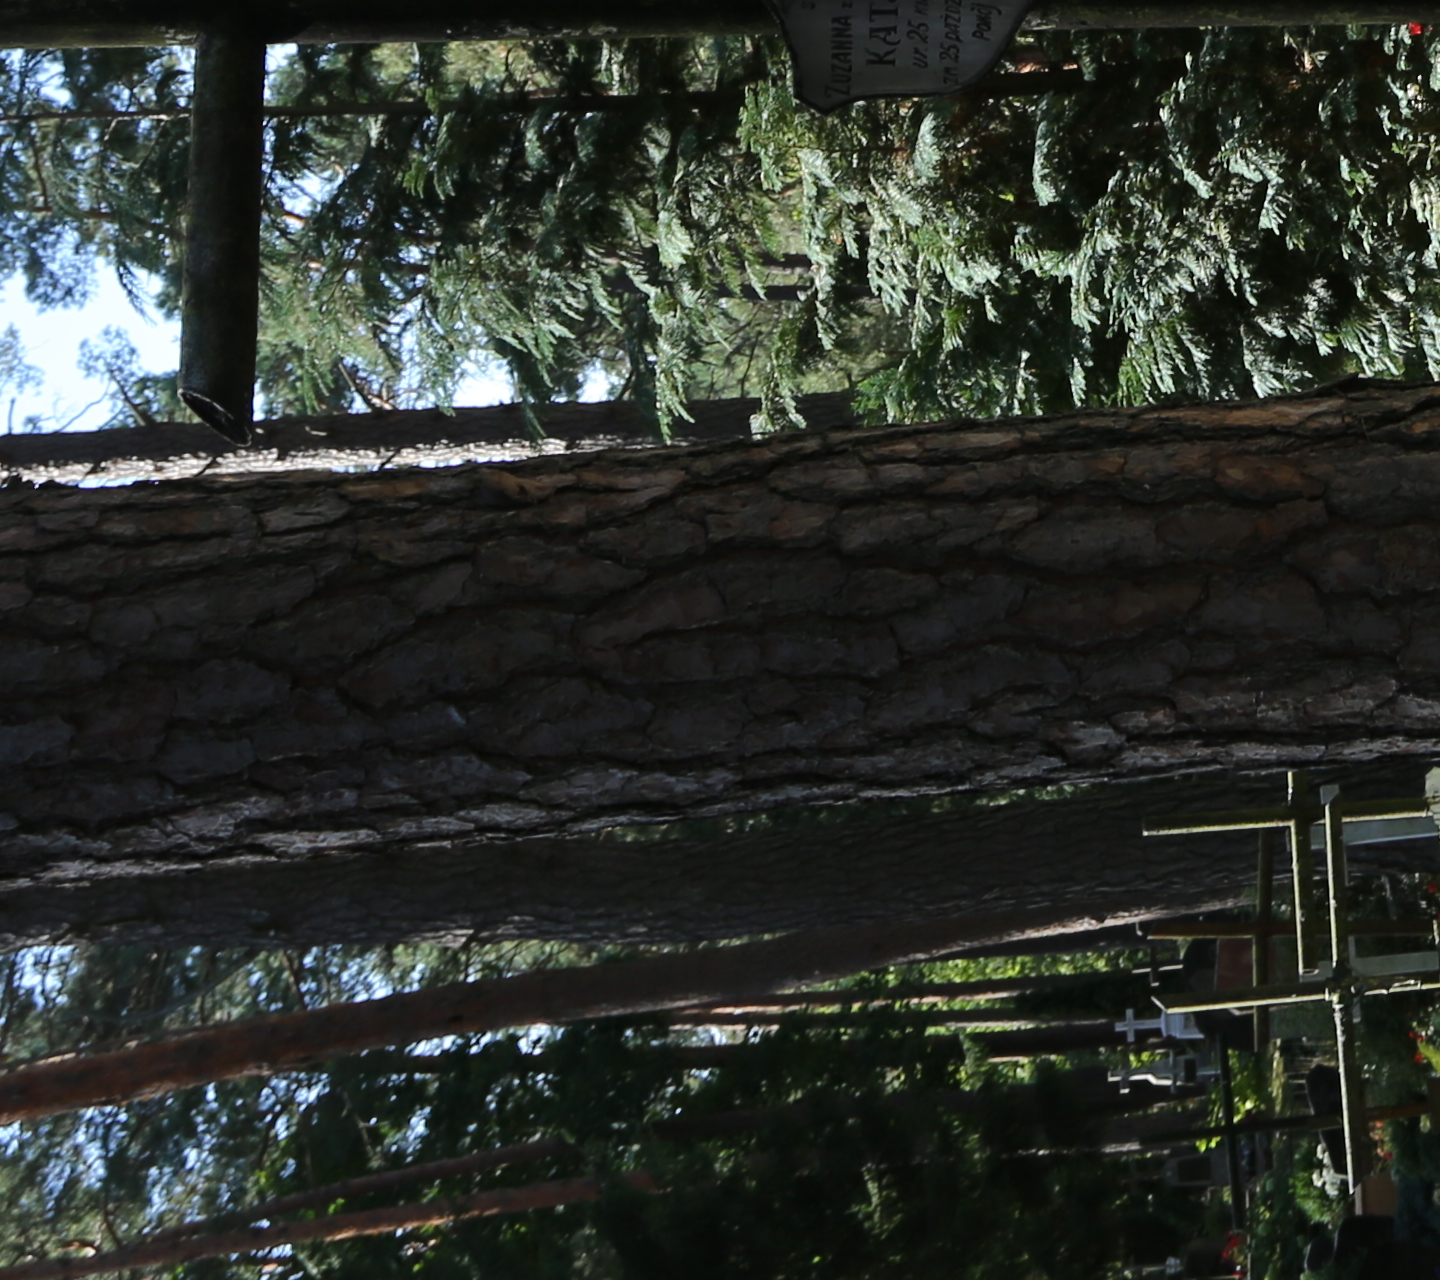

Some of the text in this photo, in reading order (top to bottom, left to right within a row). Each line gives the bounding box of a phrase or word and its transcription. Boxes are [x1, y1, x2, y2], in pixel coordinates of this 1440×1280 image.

[906, 20, 929, 43] 25
[824, 15, 853, 97] ZUZANNA
[939, 43, 960, 61] 25
